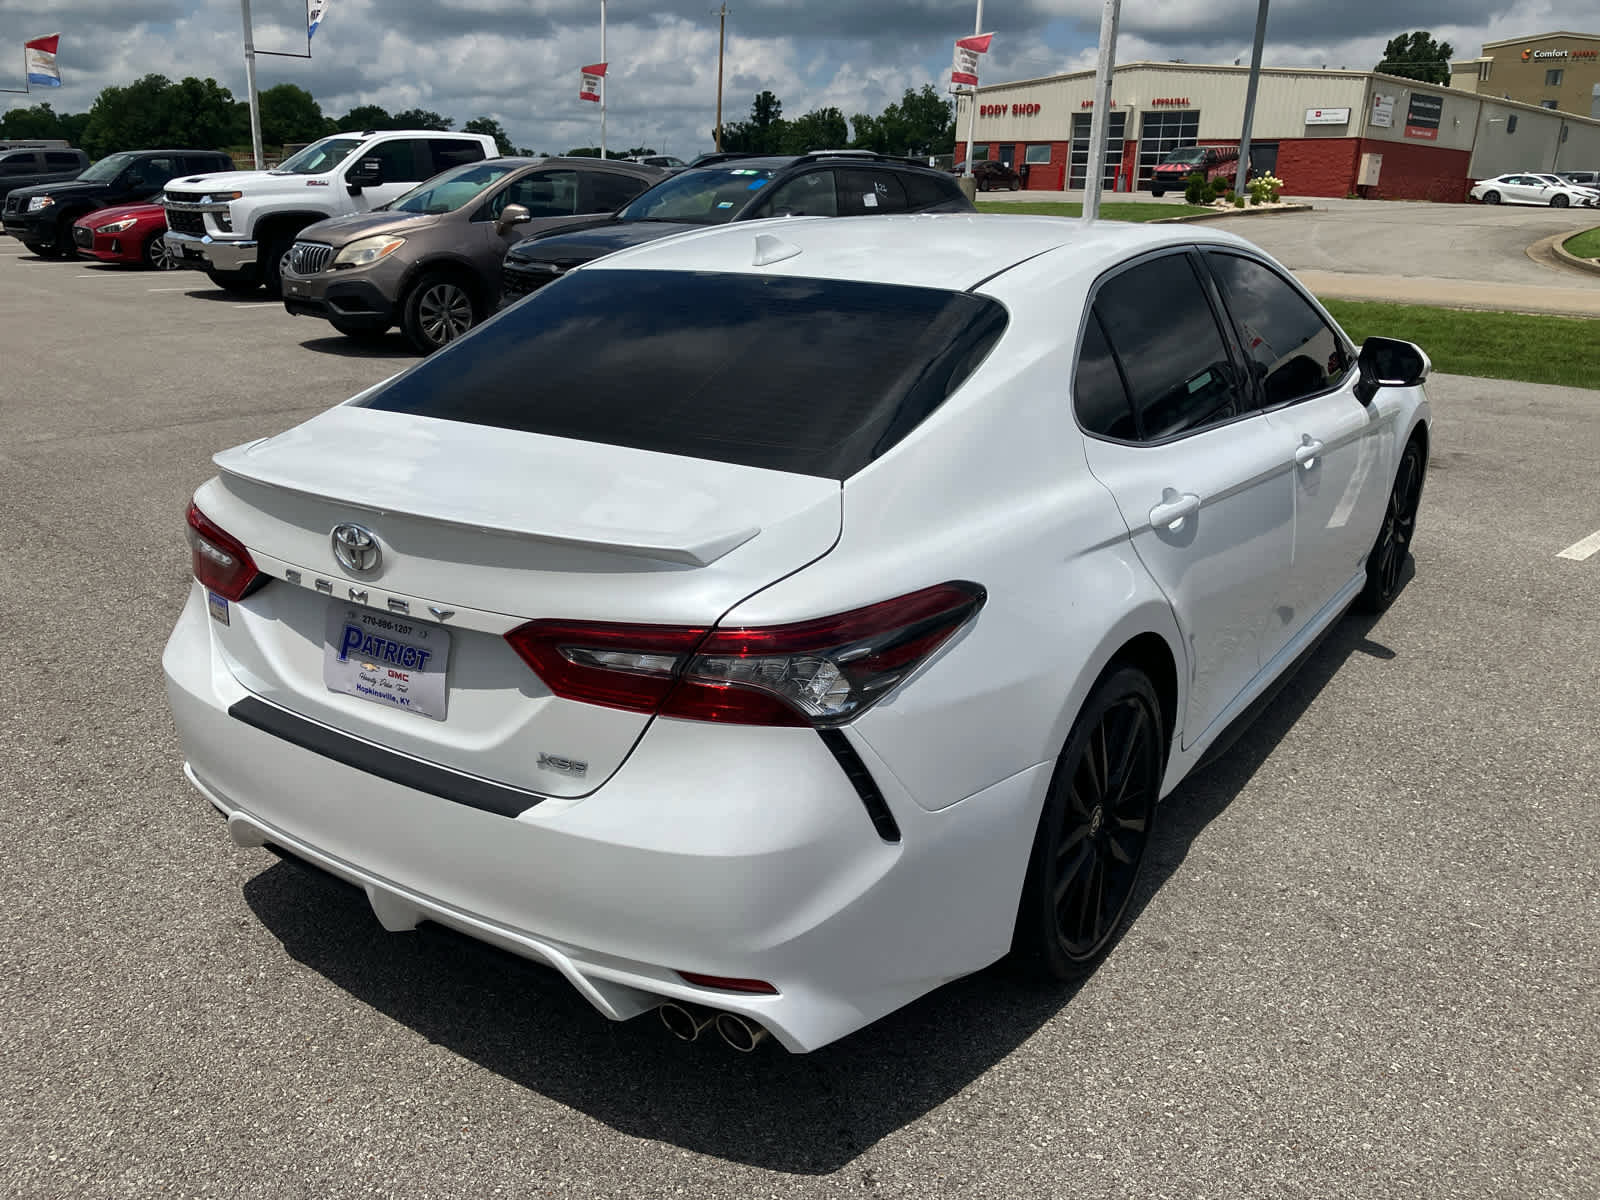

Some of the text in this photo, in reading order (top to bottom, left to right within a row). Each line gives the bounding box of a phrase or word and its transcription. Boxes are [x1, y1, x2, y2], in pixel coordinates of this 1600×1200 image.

[1534, 49, 1569, 58] Comfort
[980, 103, 1041, 117] BODY SHOP
[336, 624, 431, 671] PATRIOT
[387, 669, 409, 683] GMC
[356, 683, 410, 705] Hopkinsville, KY
